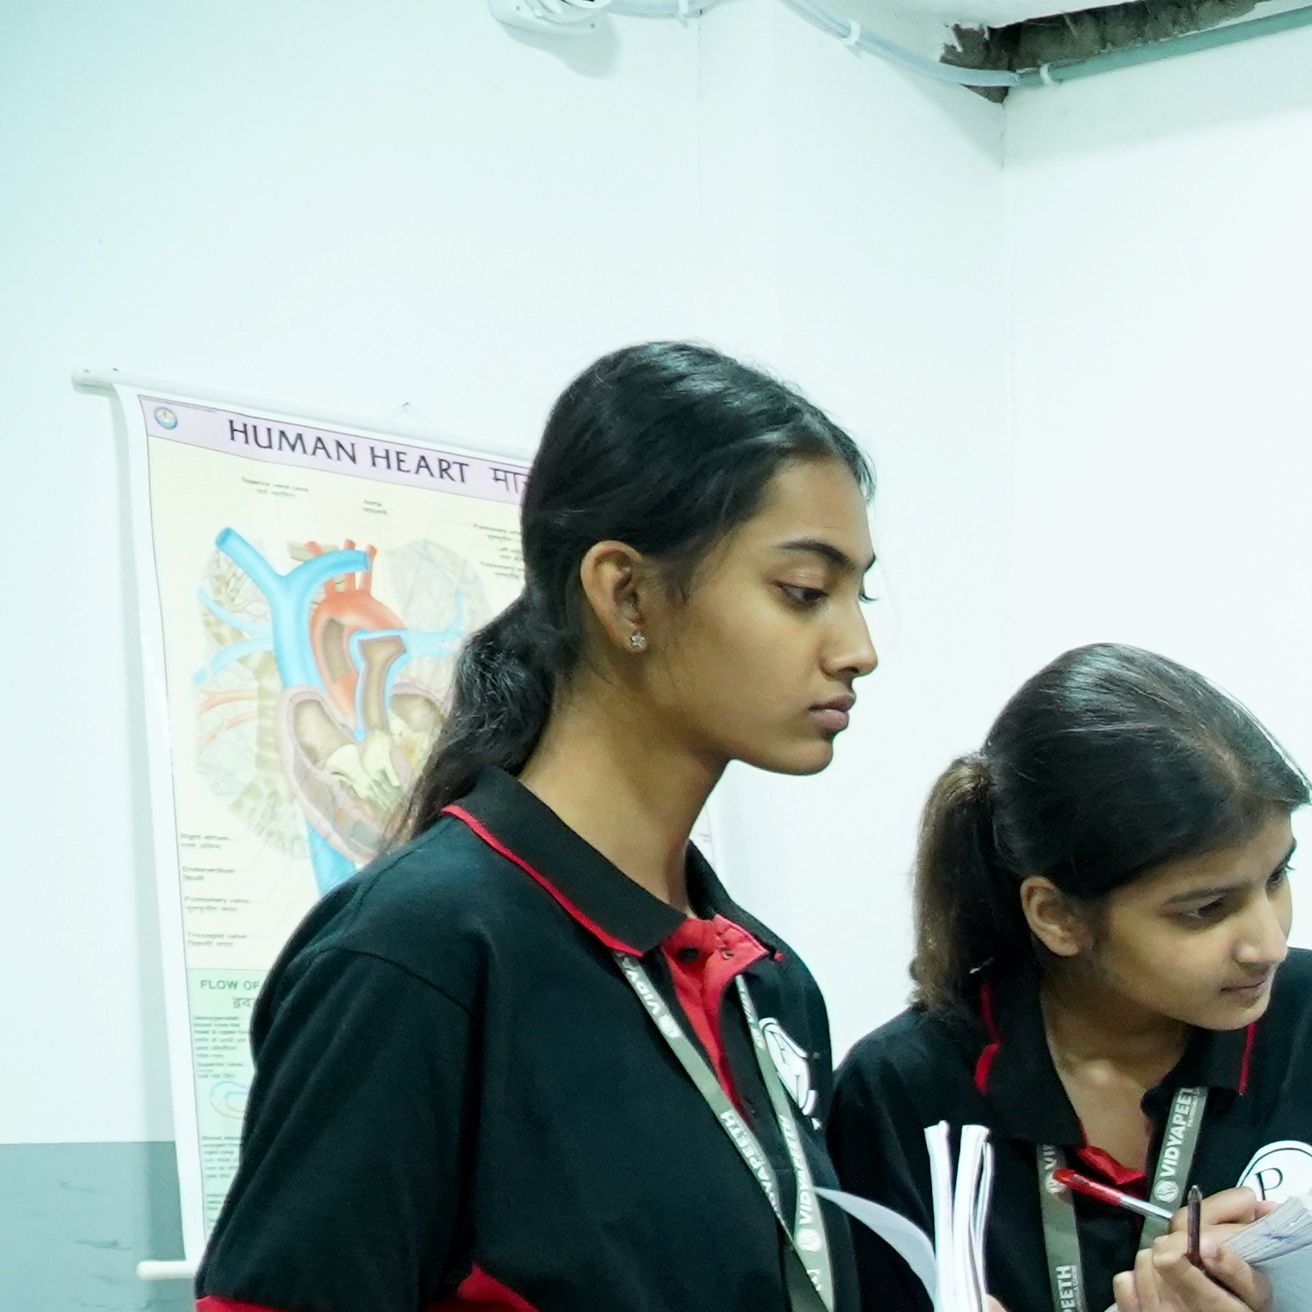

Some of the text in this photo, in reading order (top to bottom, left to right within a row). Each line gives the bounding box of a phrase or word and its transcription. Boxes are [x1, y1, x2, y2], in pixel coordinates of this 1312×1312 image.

[228, 419, 471, 485] HUMAN HEART
[200, 979, 260, 991] FLOW OF
[621, 954, 662, 1016] VIDYA
[1160, 1087, 1194, 1178] VIDYAPEET
